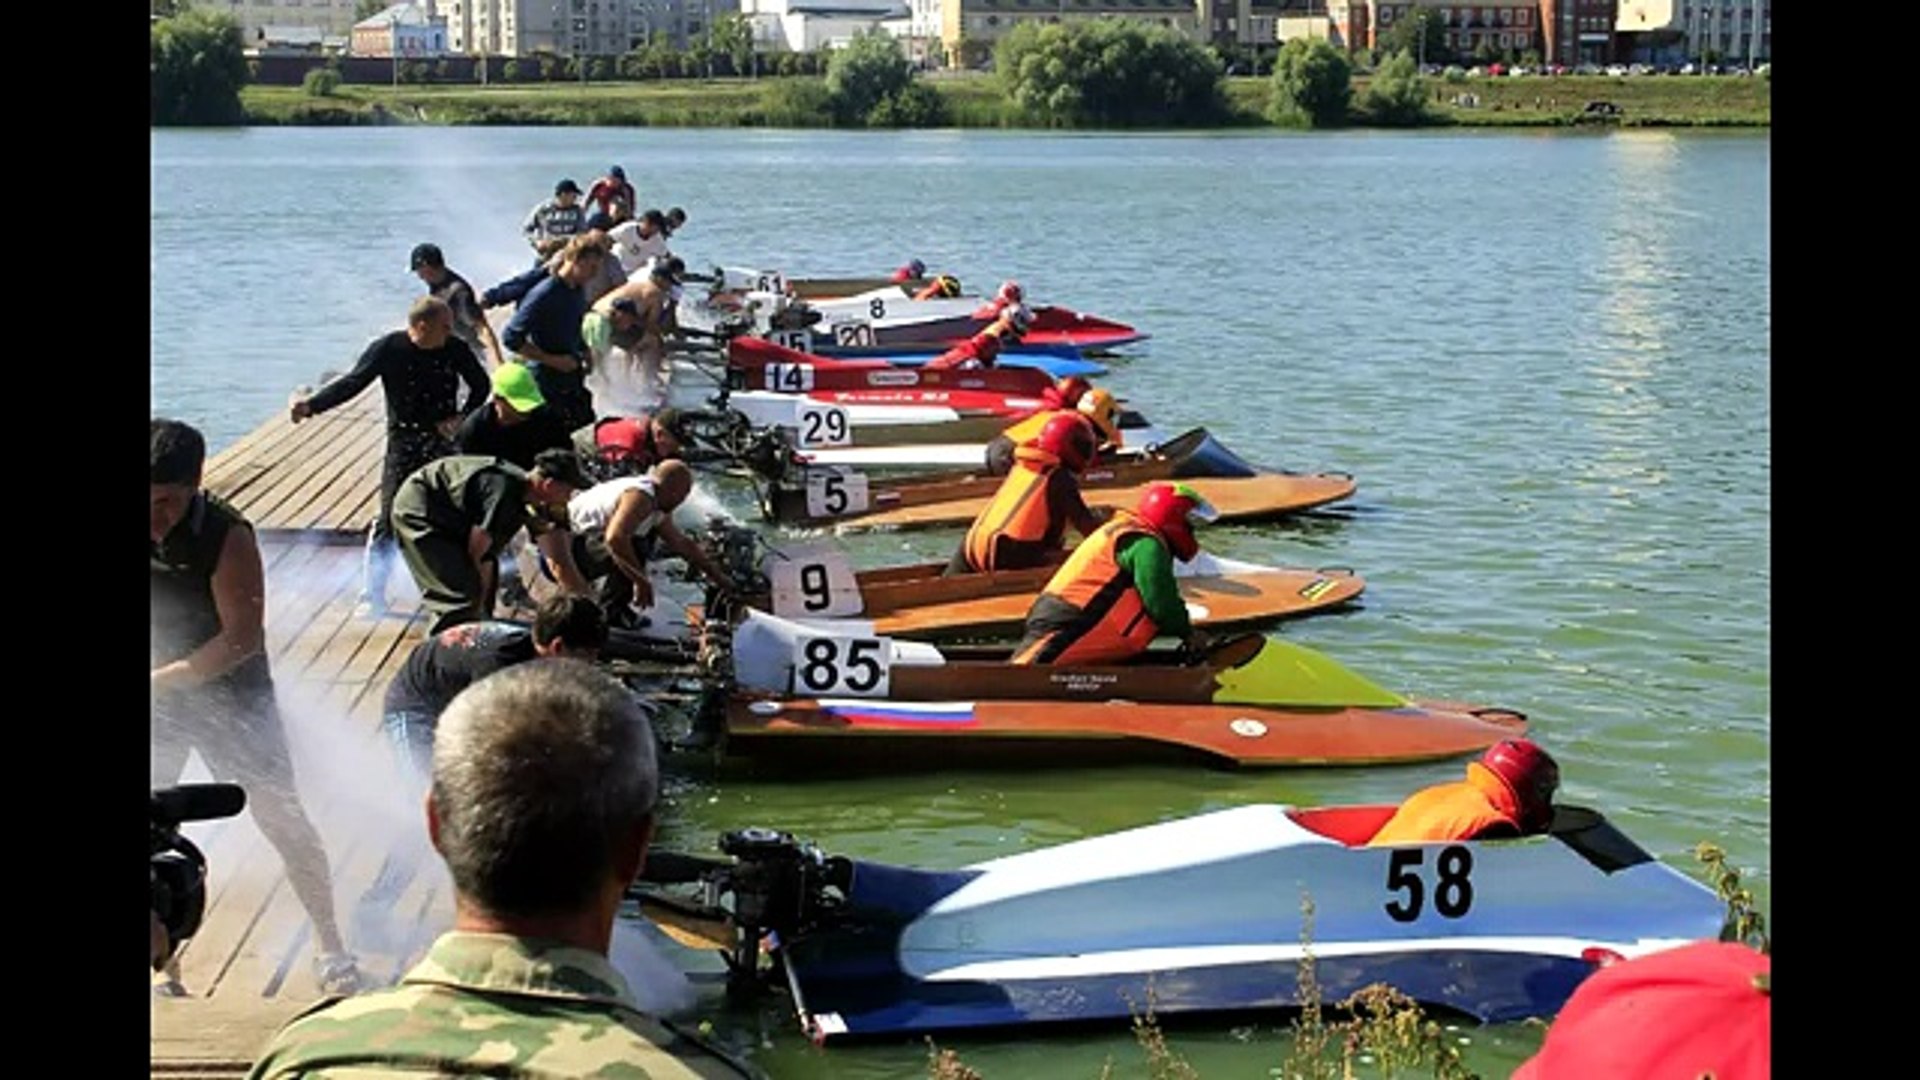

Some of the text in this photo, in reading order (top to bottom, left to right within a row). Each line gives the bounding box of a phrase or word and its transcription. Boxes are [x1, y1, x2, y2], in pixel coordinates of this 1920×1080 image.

[869, 297, 885, 319] 8
[839, 324, 872, 346] 20
[769, 364, 803, 389] 14
[804, 409, 846, 442] 29
[825, 475, 848, 514] 5
[801, 564, 830, 611] 9
[803, 638, 881, 692] 85
[1385, 845, 1473, 923] 58
